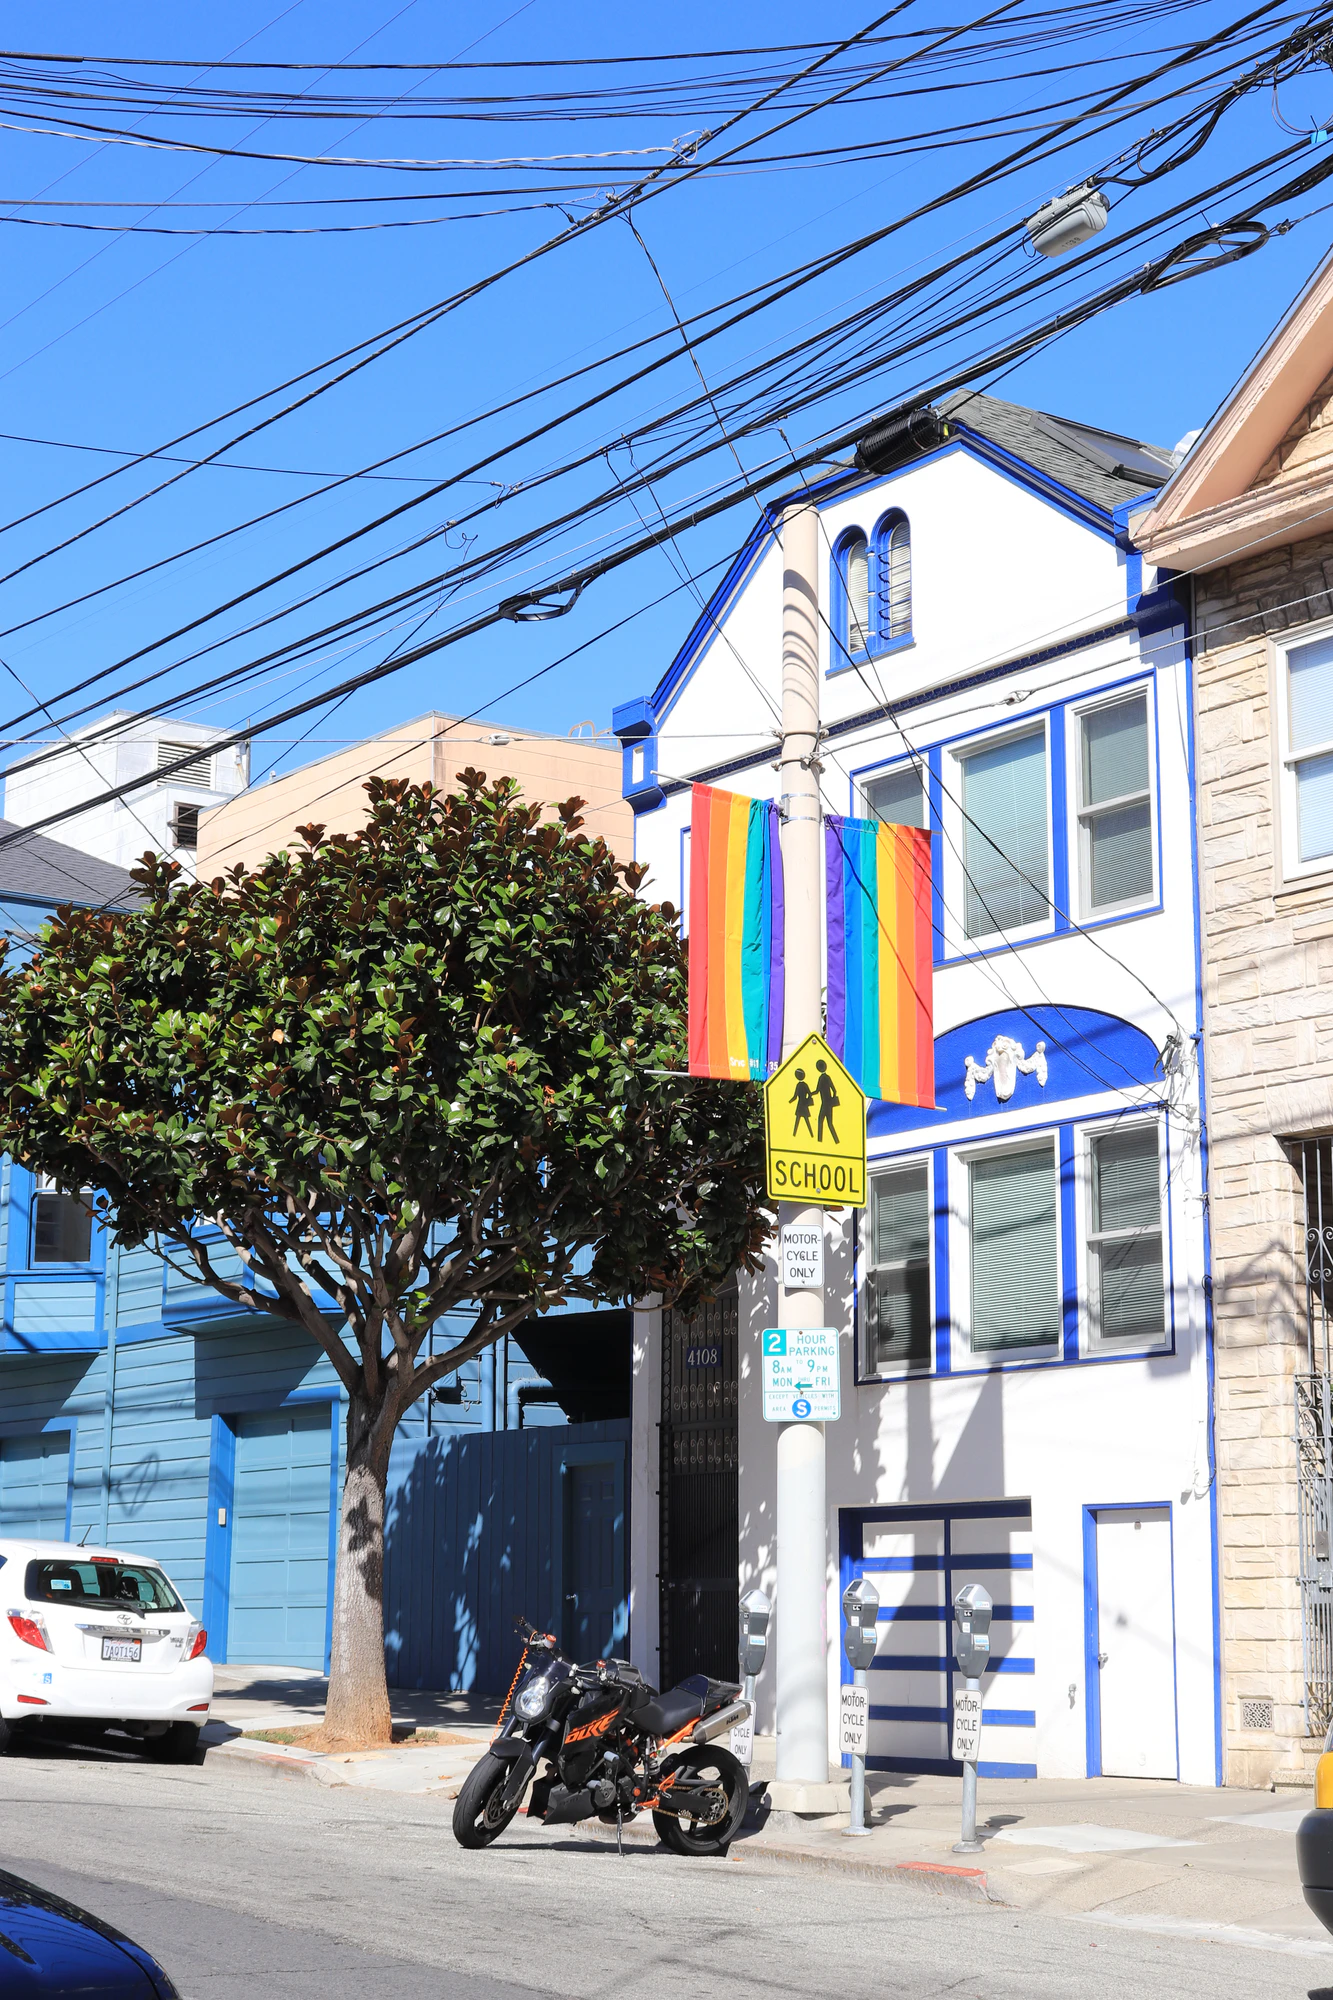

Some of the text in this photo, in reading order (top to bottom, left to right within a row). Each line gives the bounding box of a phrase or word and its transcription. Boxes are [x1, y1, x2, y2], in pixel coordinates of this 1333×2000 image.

[775, 1159, 860, 1193] SCHOOL
[784, 1233, 821, 1244] MOTOR-
[786, 1250, 819, 1261] CYCLE
[789, 1267, 816, 1278] ONLY
[768, 1333, 826, 1352] 2 HOUR
[687, 1348, 718, 1366] 4108
[789, 1346, 835, 1356] PARKING
[772, 1377, 793, 1387] MON
[815, 1376, 831, 1386] FRI
[796, 1401, 808, 1416] S
[841, 1694, 867, 1708] MOTOR-
[955, 1699, 980, 1712] MOTOR-
[842, 1712, 865, 1727] CYCLE
[956, 1718, 977, 1732] CYCLE
[564, 1709, 619, 1744] DUKE
[733, 1726, 750, 1738] CYCLE
[843, 1731, 862, 1744] ONLY
[957, 1737, 975, 1750] ONLY
[734, 1744, 748, 1755] ONLY
